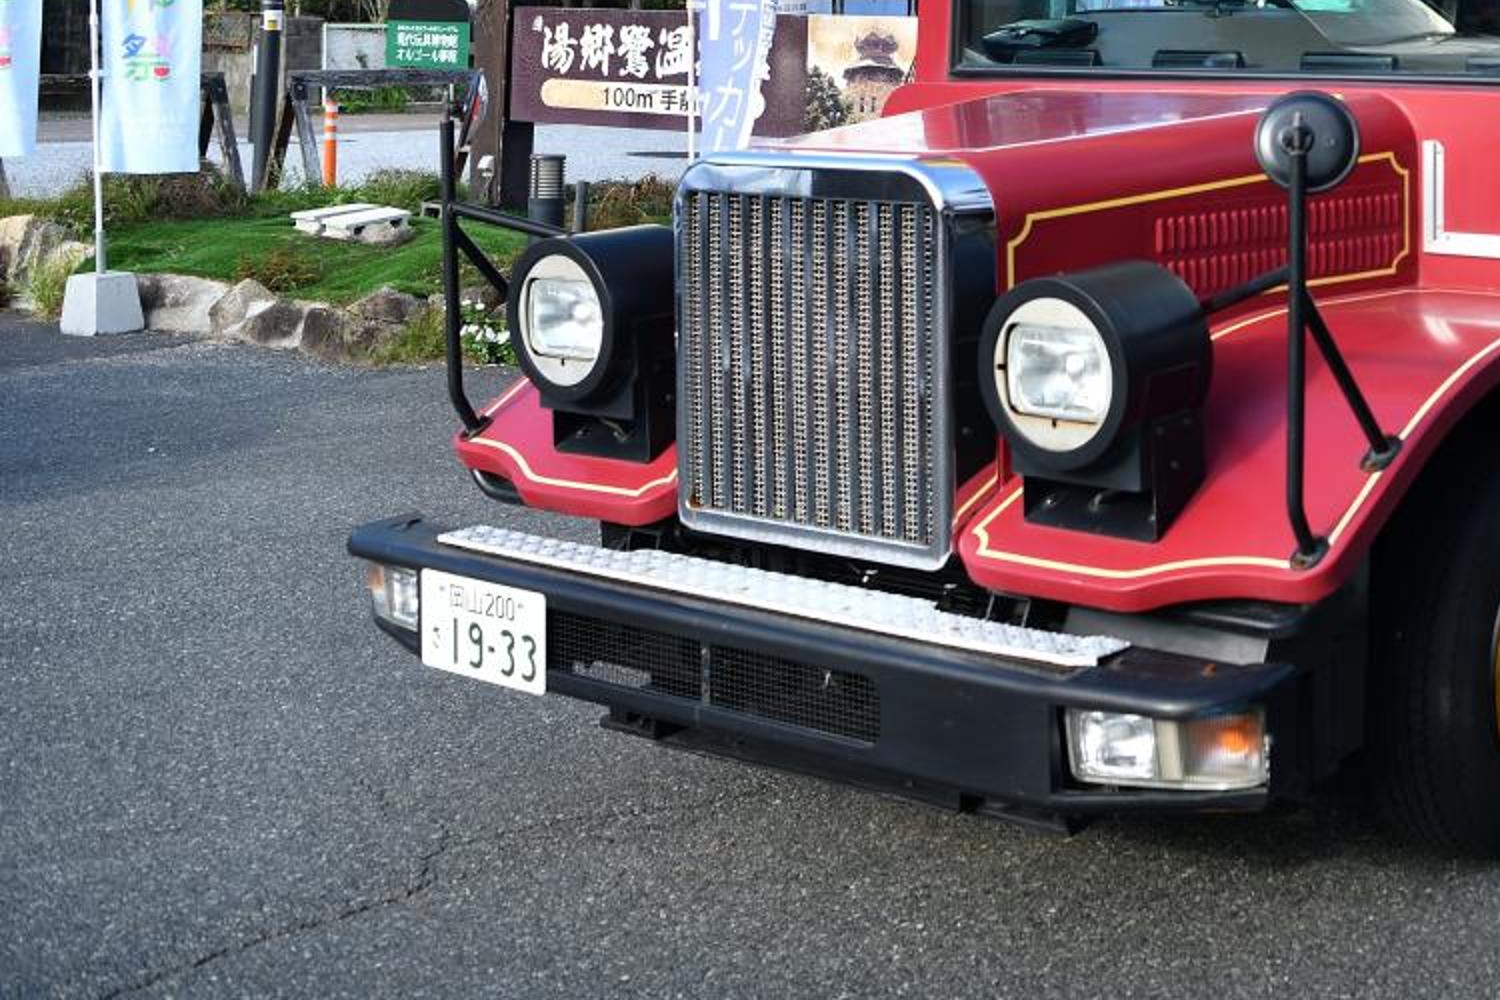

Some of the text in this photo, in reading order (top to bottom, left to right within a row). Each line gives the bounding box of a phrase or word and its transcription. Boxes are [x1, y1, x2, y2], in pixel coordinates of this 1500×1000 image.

[541, 20, 702, 80] 湯郷鷺温
[453, 617, 537, 683] 19-33
